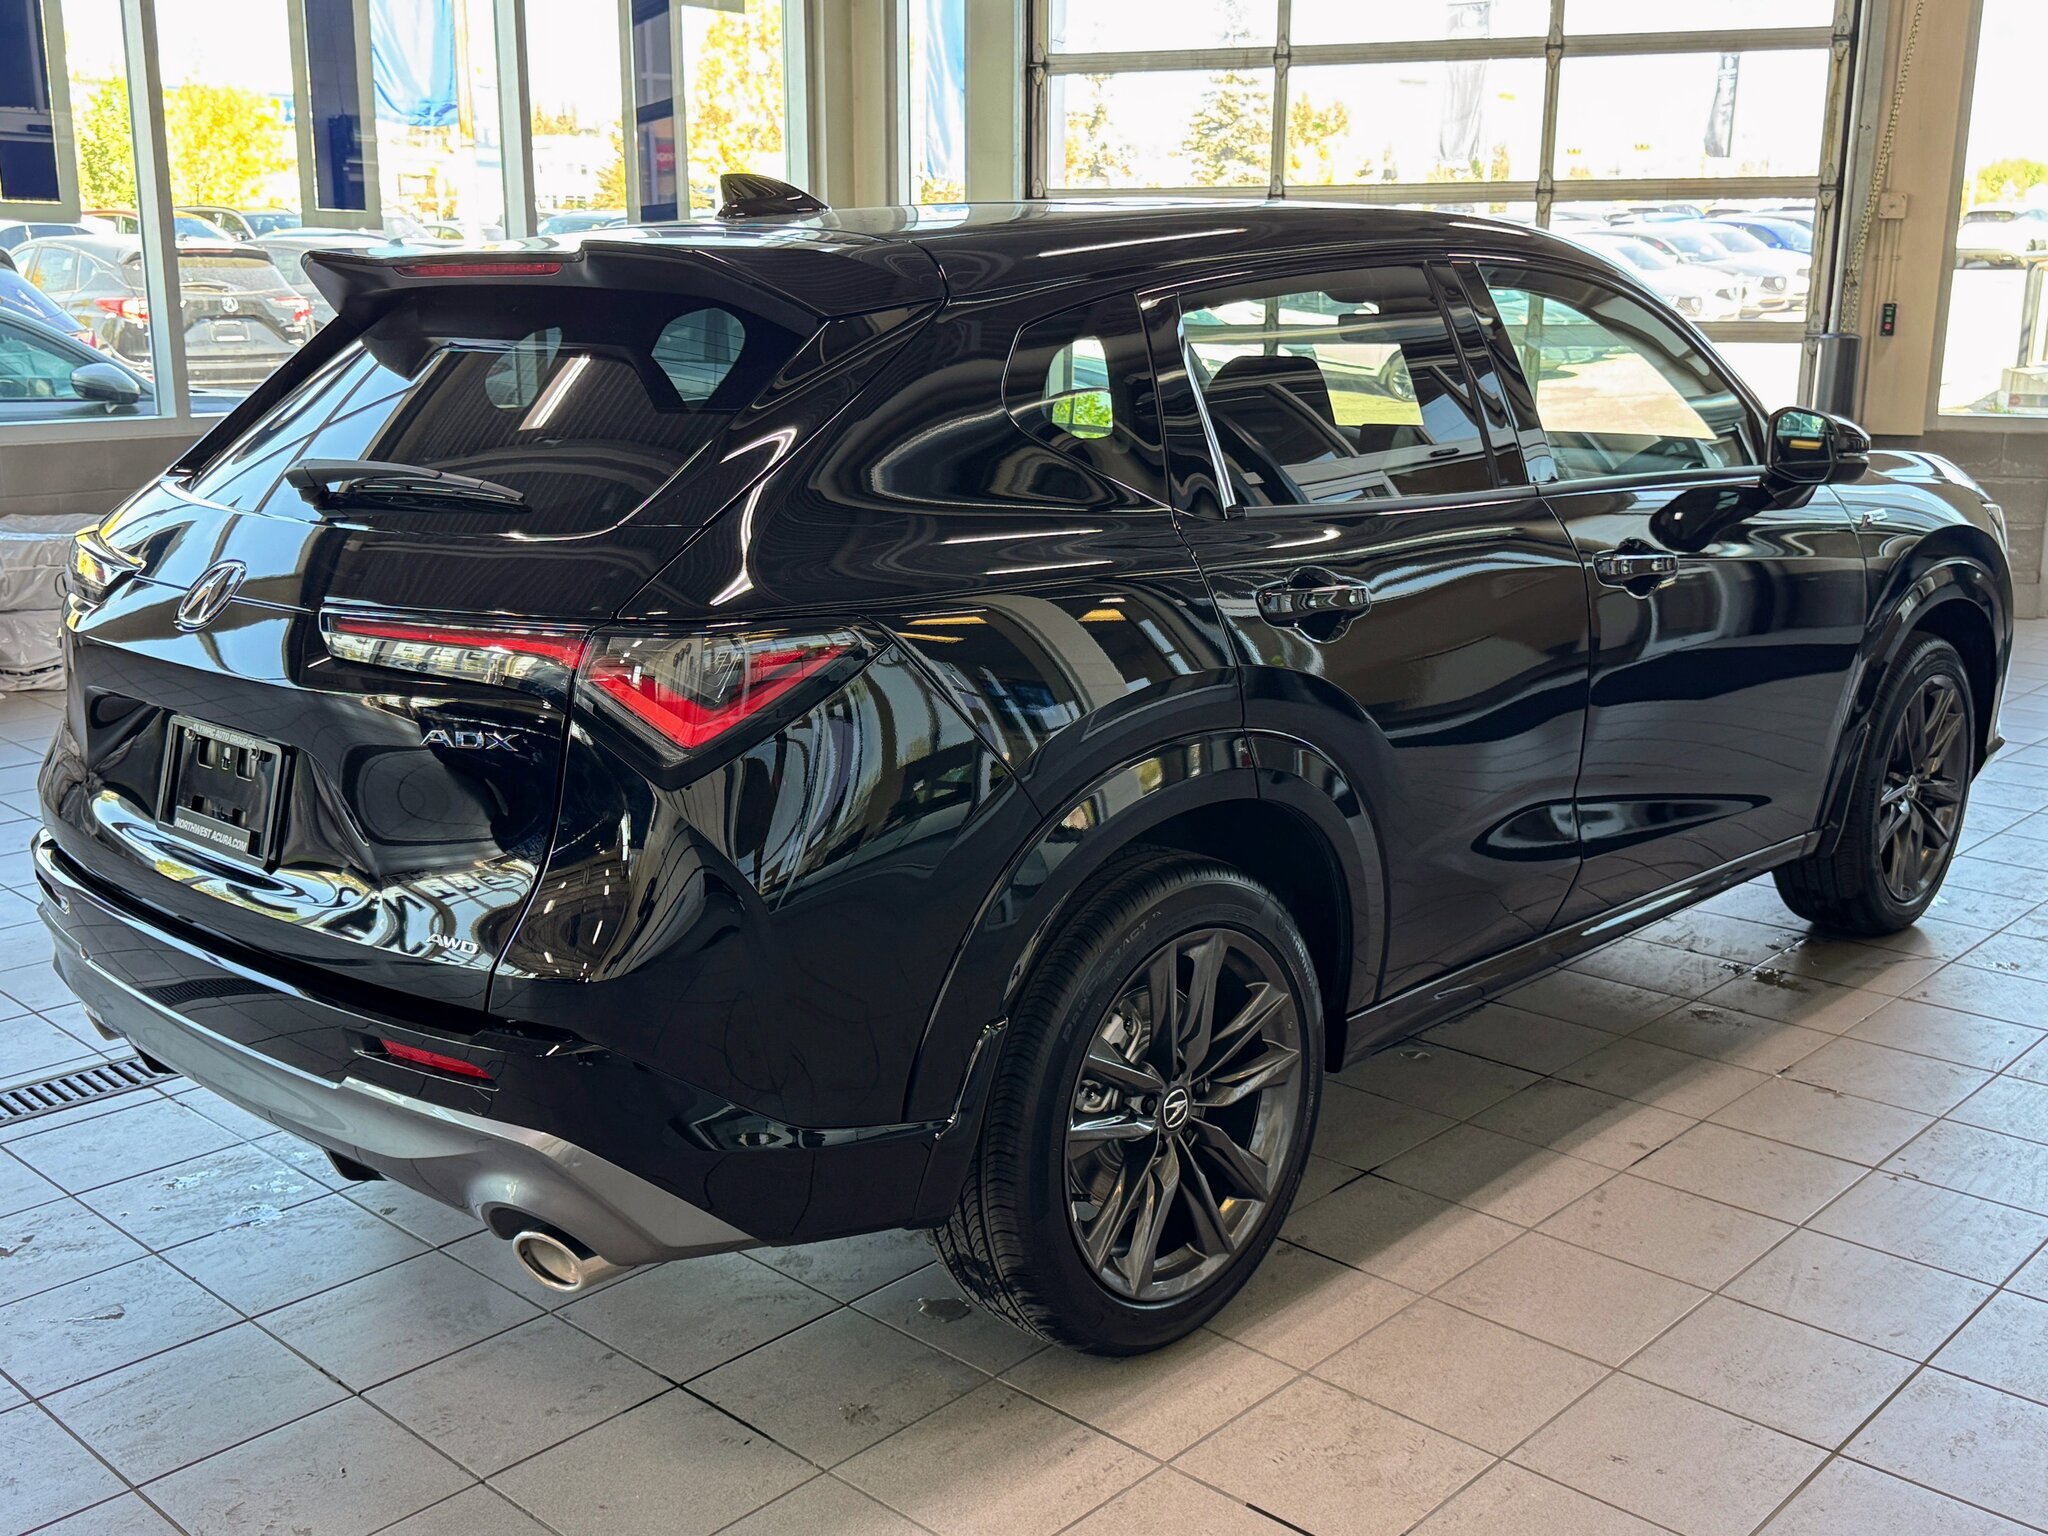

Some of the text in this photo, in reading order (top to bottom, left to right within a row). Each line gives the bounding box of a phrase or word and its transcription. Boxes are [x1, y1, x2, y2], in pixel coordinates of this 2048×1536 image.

[420, 729, 519, 752] ADX
[174, 817, 248, 852] NORTHWEST ACURA.COM
[425, 933, 480, 955] AWD
